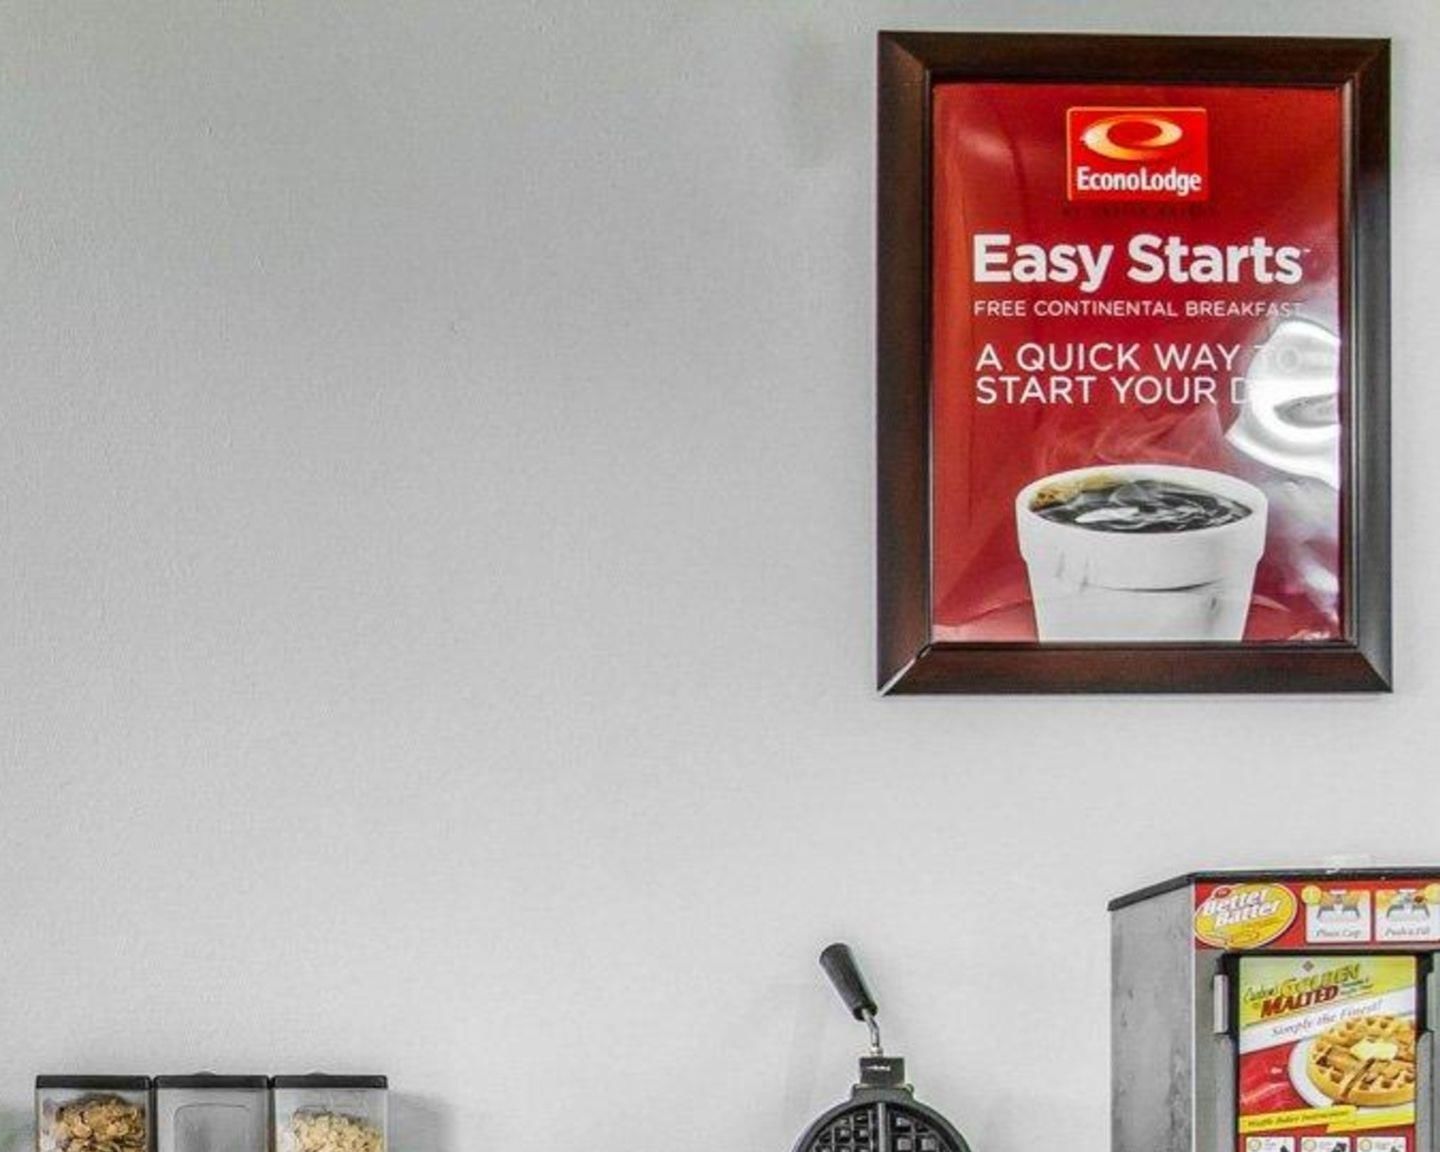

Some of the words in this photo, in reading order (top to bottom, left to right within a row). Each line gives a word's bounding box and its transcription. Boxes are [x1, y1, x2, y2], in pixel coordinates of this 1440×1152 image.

[1076, 166, 1202, 197] EconoLodge
[972, 233, 1114, 293] Easy
[1126, 233, 1304, 284] Starts
[974, 300, 1027, 317] FREE
[1033, 300, 1179, 317] CONTINENTAL
[975, 343, 1003, 372] A
[1016, 342, 1142, 375] QUICK
[1153, 343, 1242, 372] WAY
[975, 376, 1097, 404] START
[1109, 376, 1218, 404] YOUR
[1260, 985, 1339, 1018] MALTED
[1316, 1009, 1338, 1025] the
